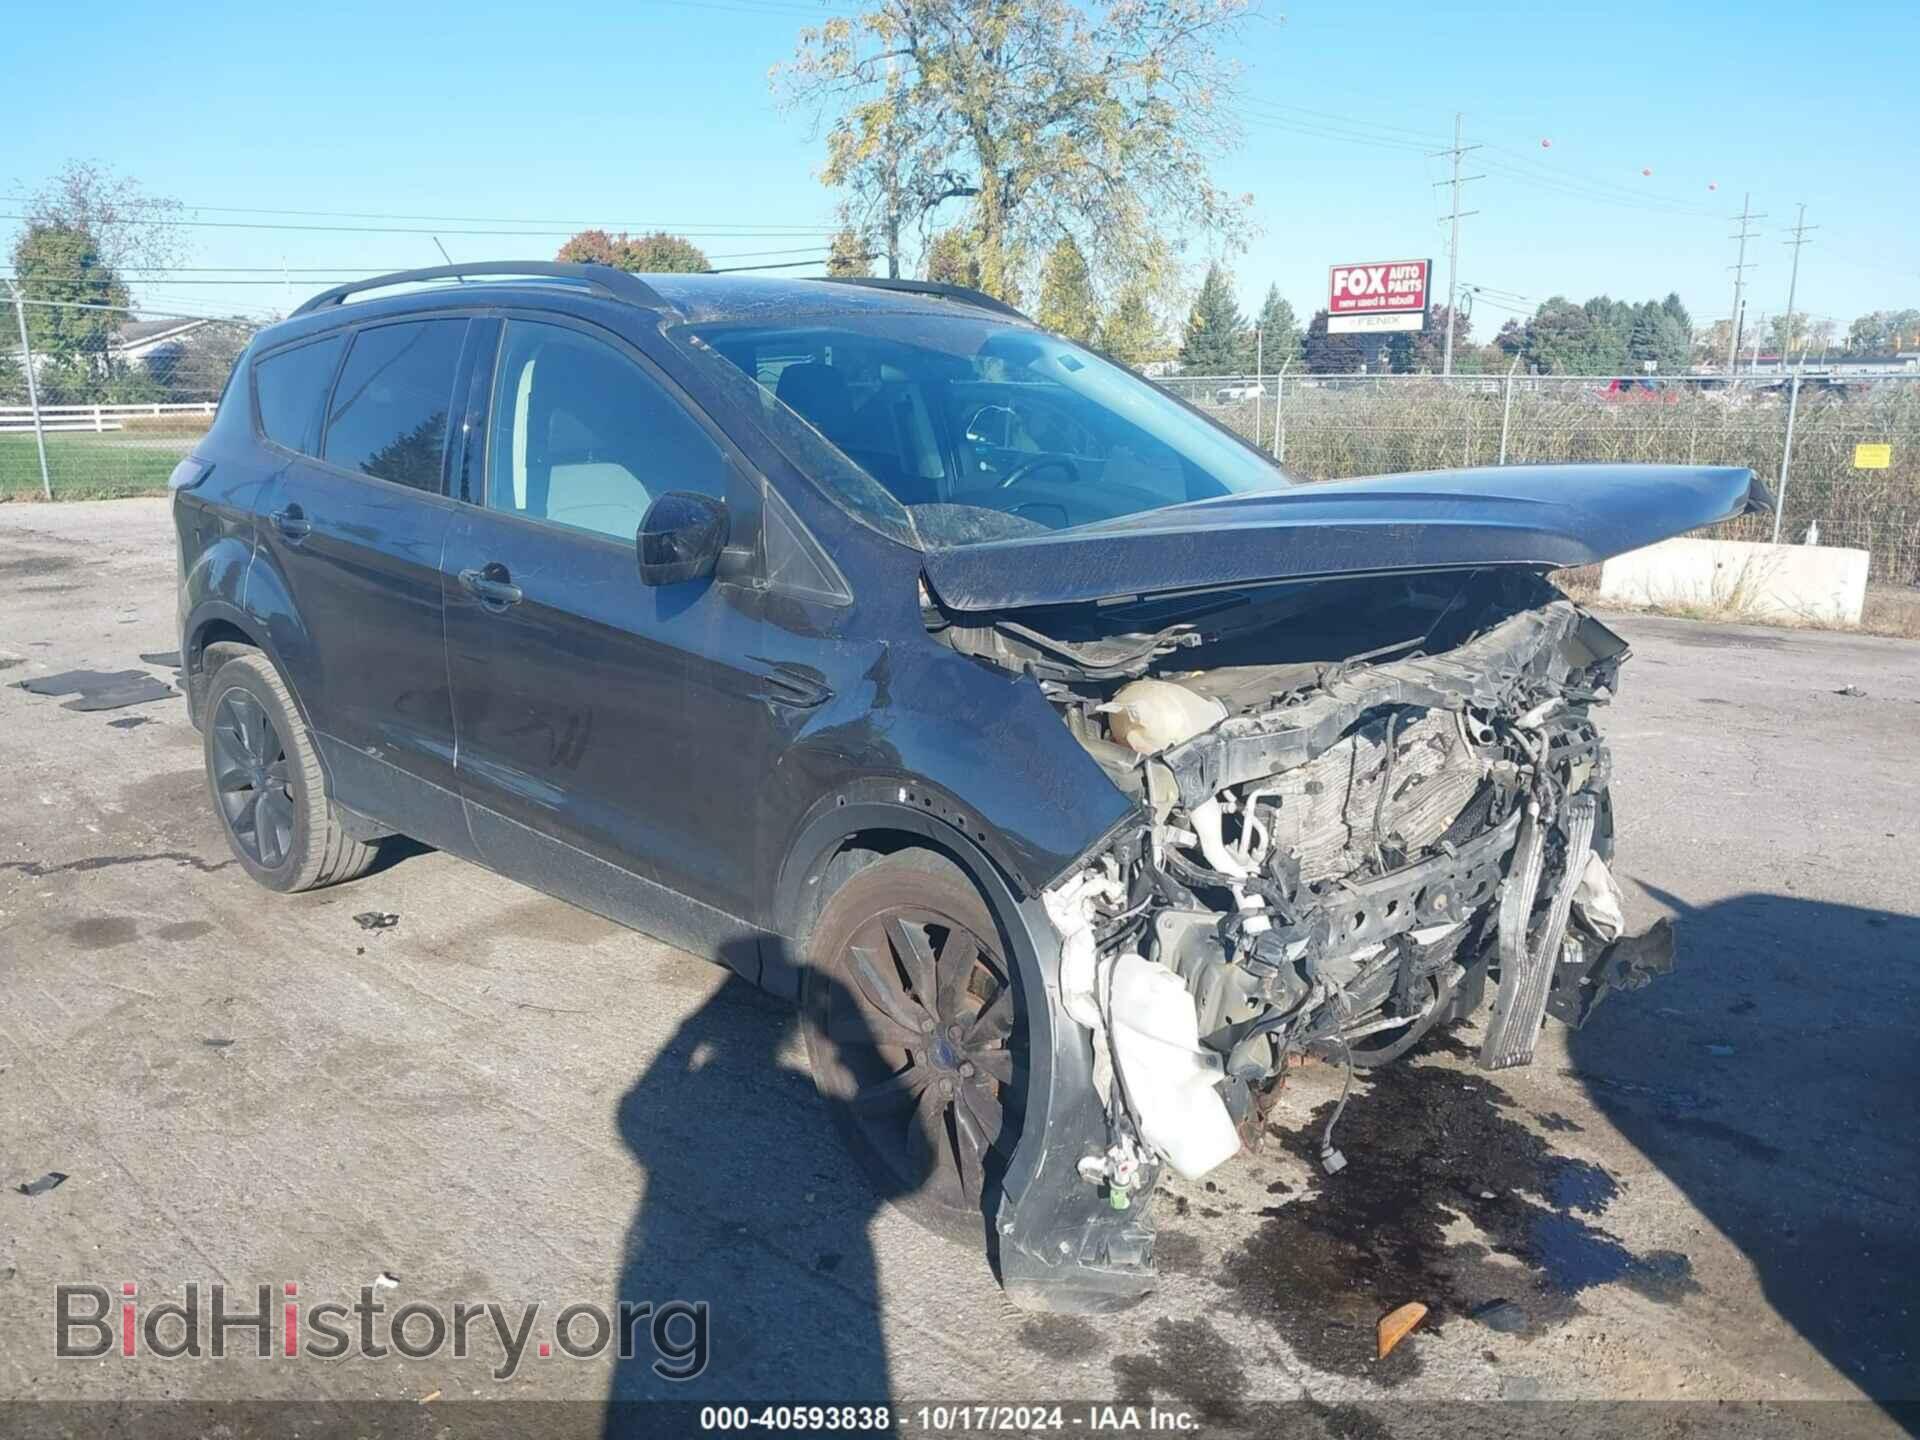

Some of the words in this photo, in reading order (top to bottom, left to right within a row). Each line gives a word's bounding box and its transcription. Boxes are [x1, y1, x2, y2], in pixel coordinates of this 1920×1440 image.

[1389, 266, 1420, 279] AUTO
[1333, 267, 1386, 297] FOX
[1387, 279, 1422, 293] PARTS
[1357, 297, 1378, 307] used
